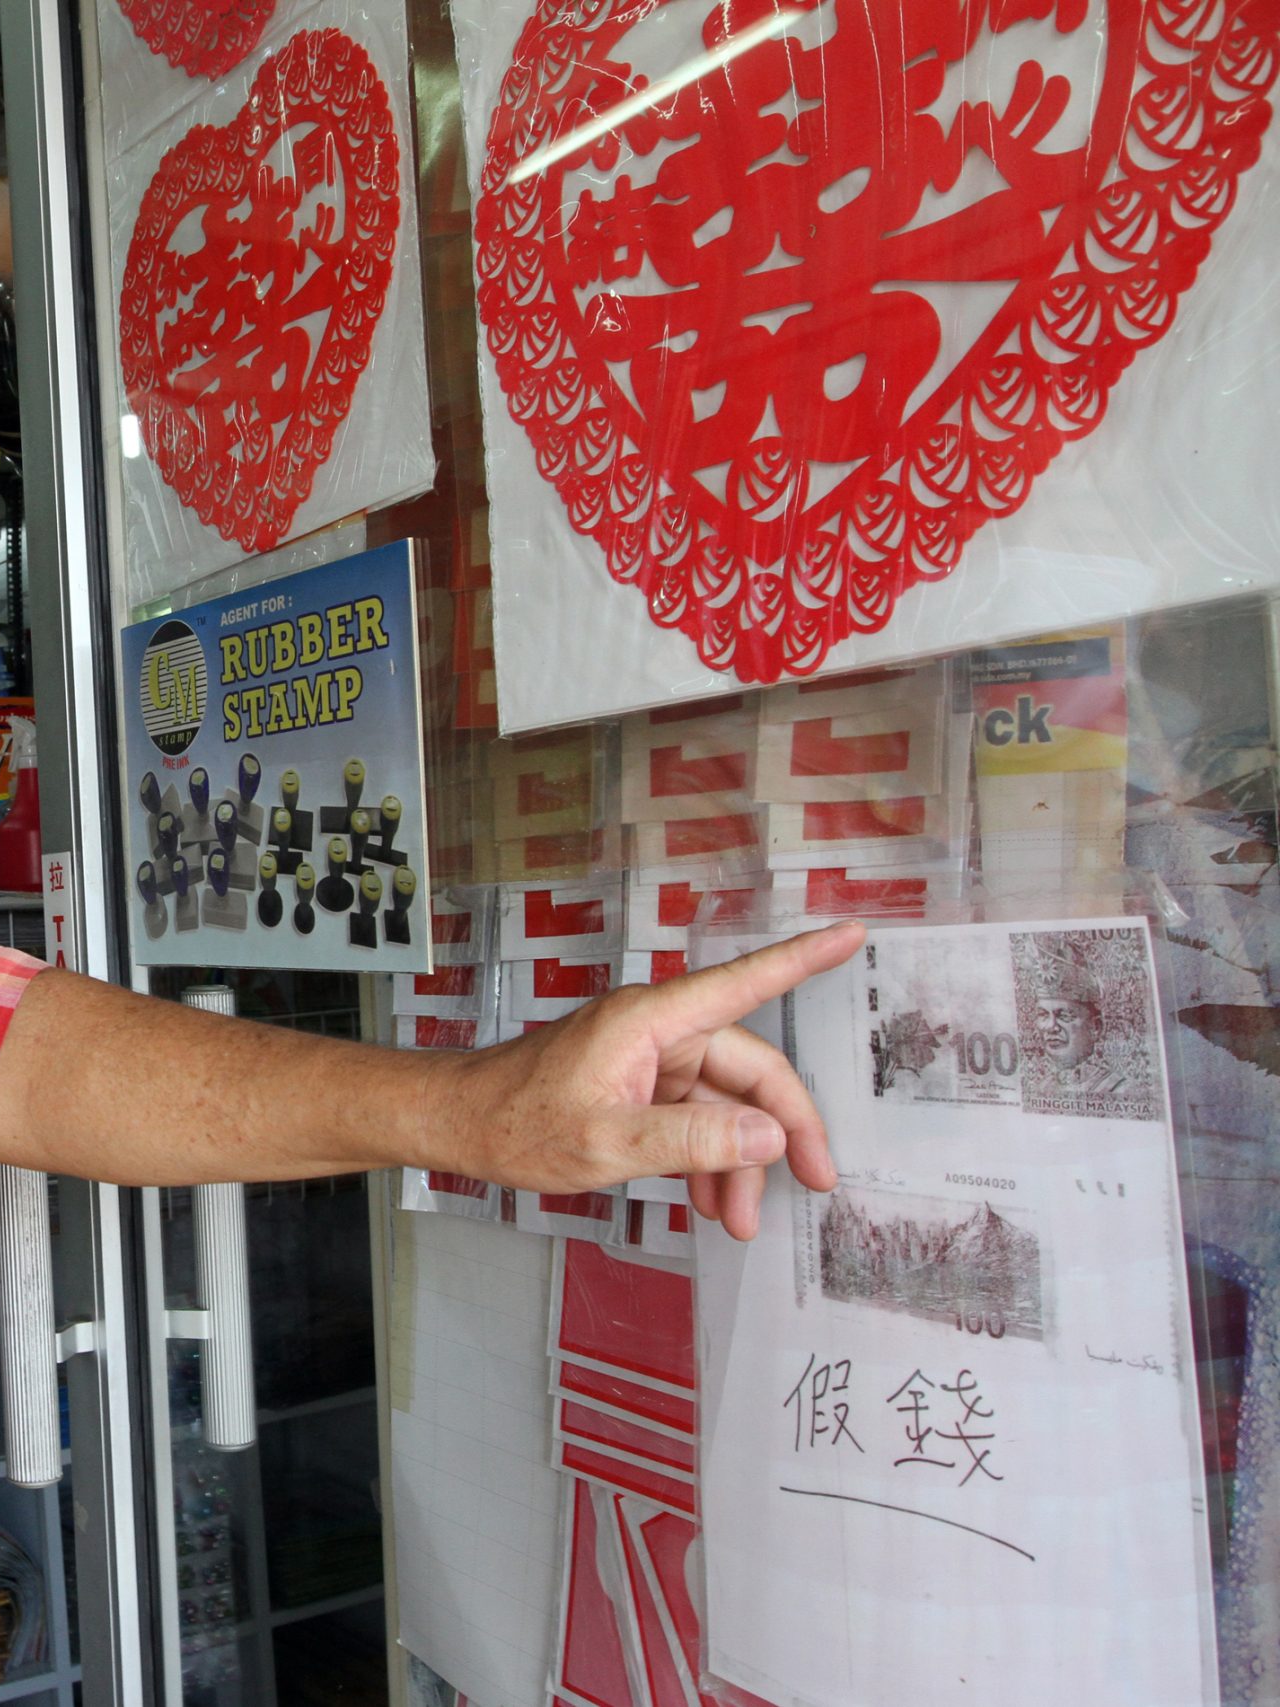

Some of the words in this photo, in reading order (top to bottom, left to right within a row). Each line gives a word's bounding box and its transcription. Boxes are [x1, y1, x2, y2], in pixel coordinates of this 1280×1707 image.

[220, 604, 258, 627] AGENT
[261, 595, 286, 612] FOR
[220, 594, 389, 684] RUBBER
[224, 665, 363, 742] STAMP
[973, 696, 1052, 746] ck
[158, 731, 192, 747] stamp
[49, 861, 65, 892] 拉
[950, 1031, 1019, 1077] 100
[1030, 1098, 1082, 1110] RINGGIT
[1086, 1102, 1152, 1114] MALAYSIA
